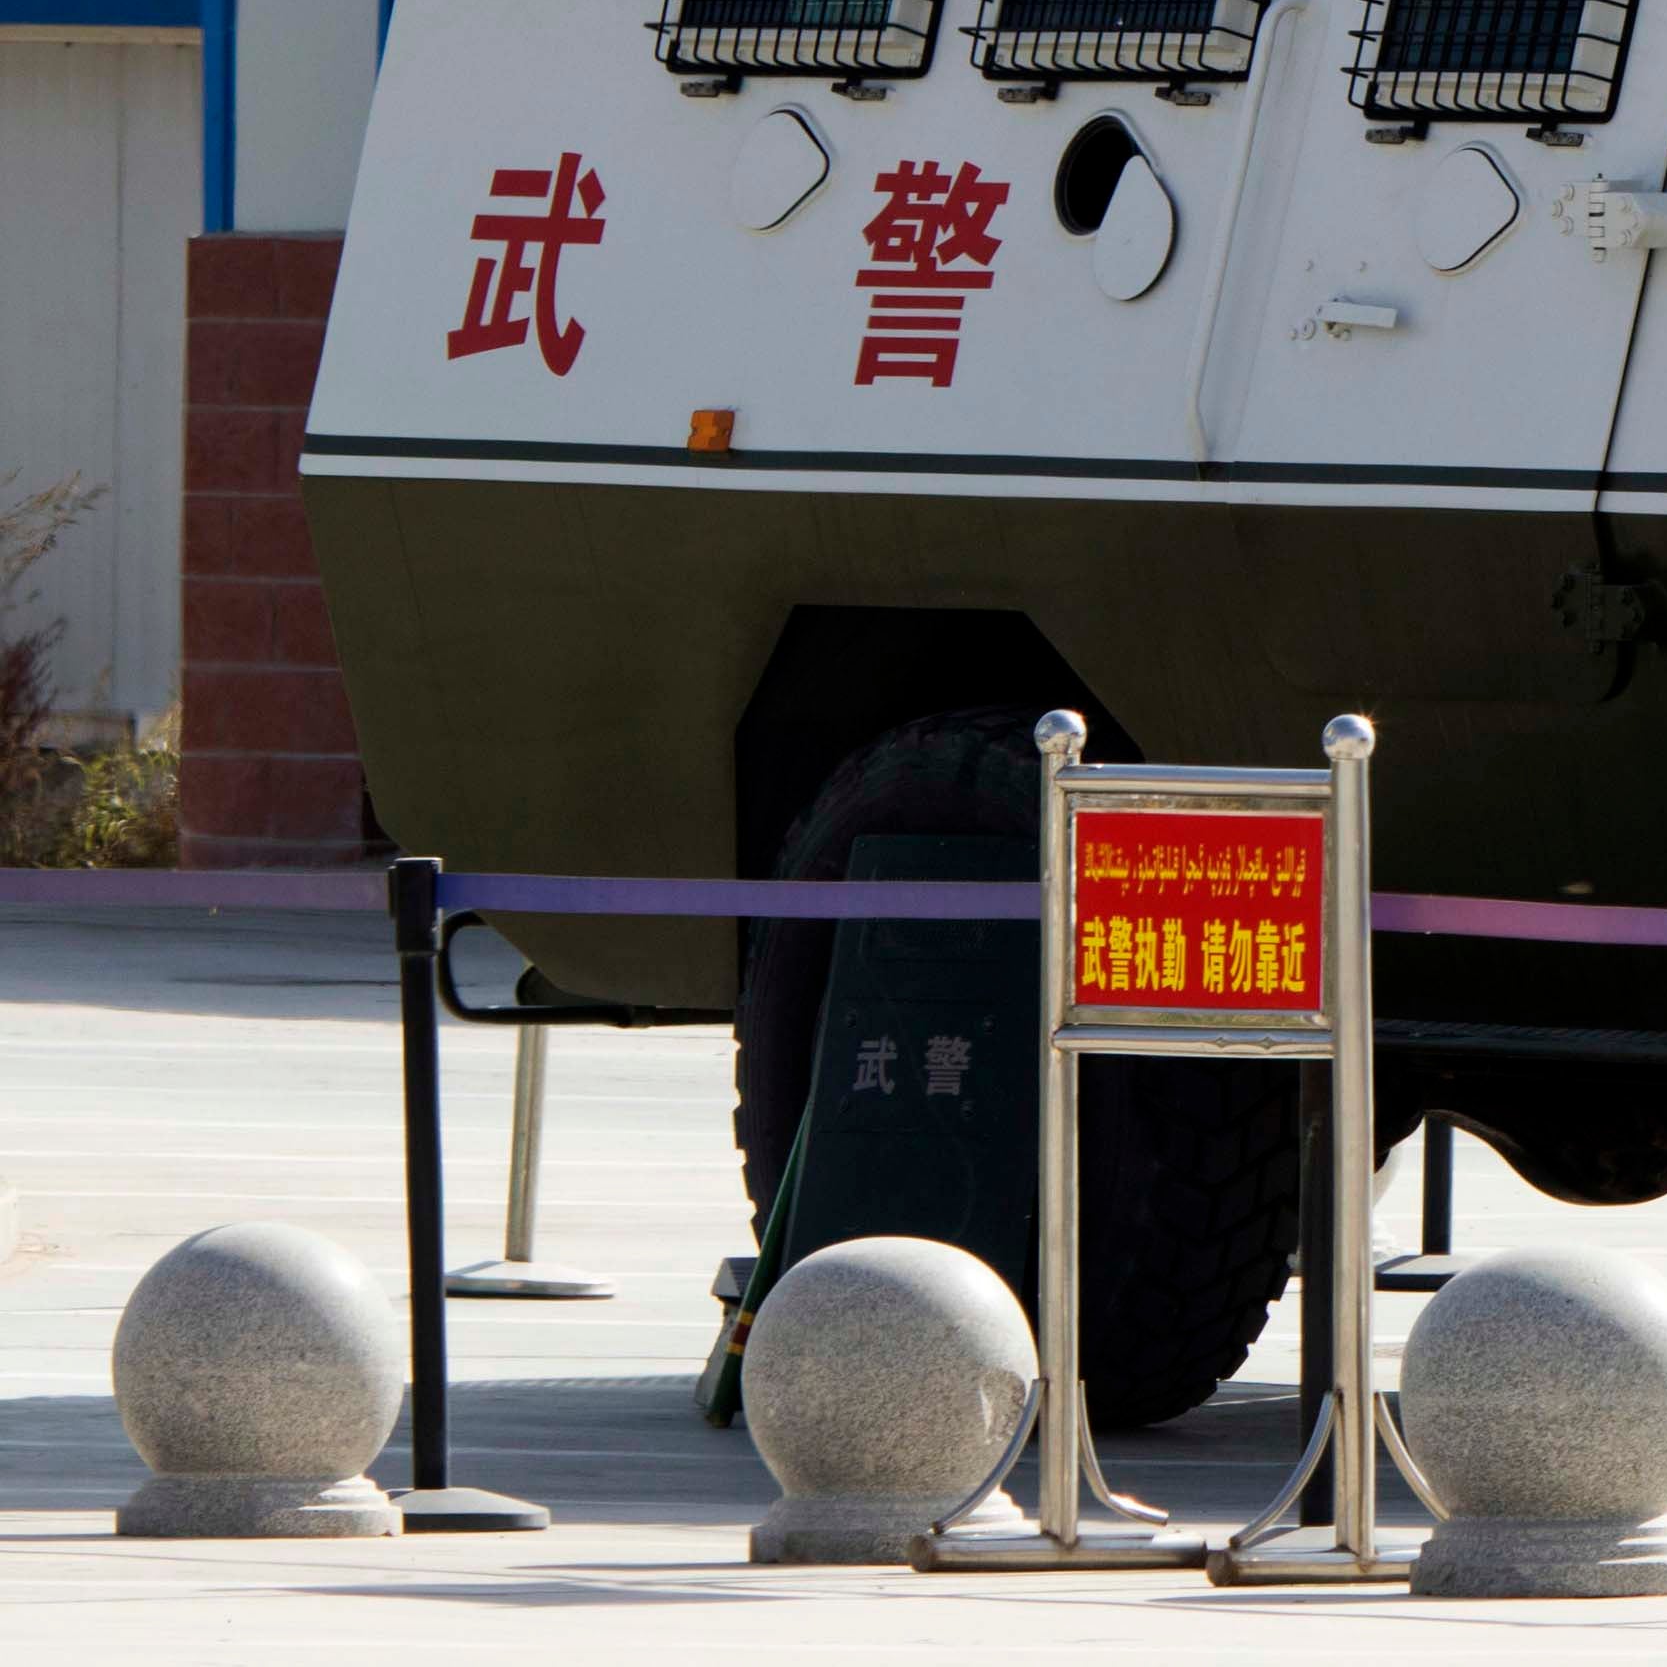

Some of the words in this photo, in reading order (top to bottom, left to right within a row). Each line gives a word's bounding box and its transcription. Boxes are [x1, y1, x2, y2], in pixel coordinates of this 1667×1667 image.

[1082, 915, 1186, 992] 武警执勤
[1201, 918, 1306, 994] 请勿靠近
[852, 1035, 973, 1096] 武警
